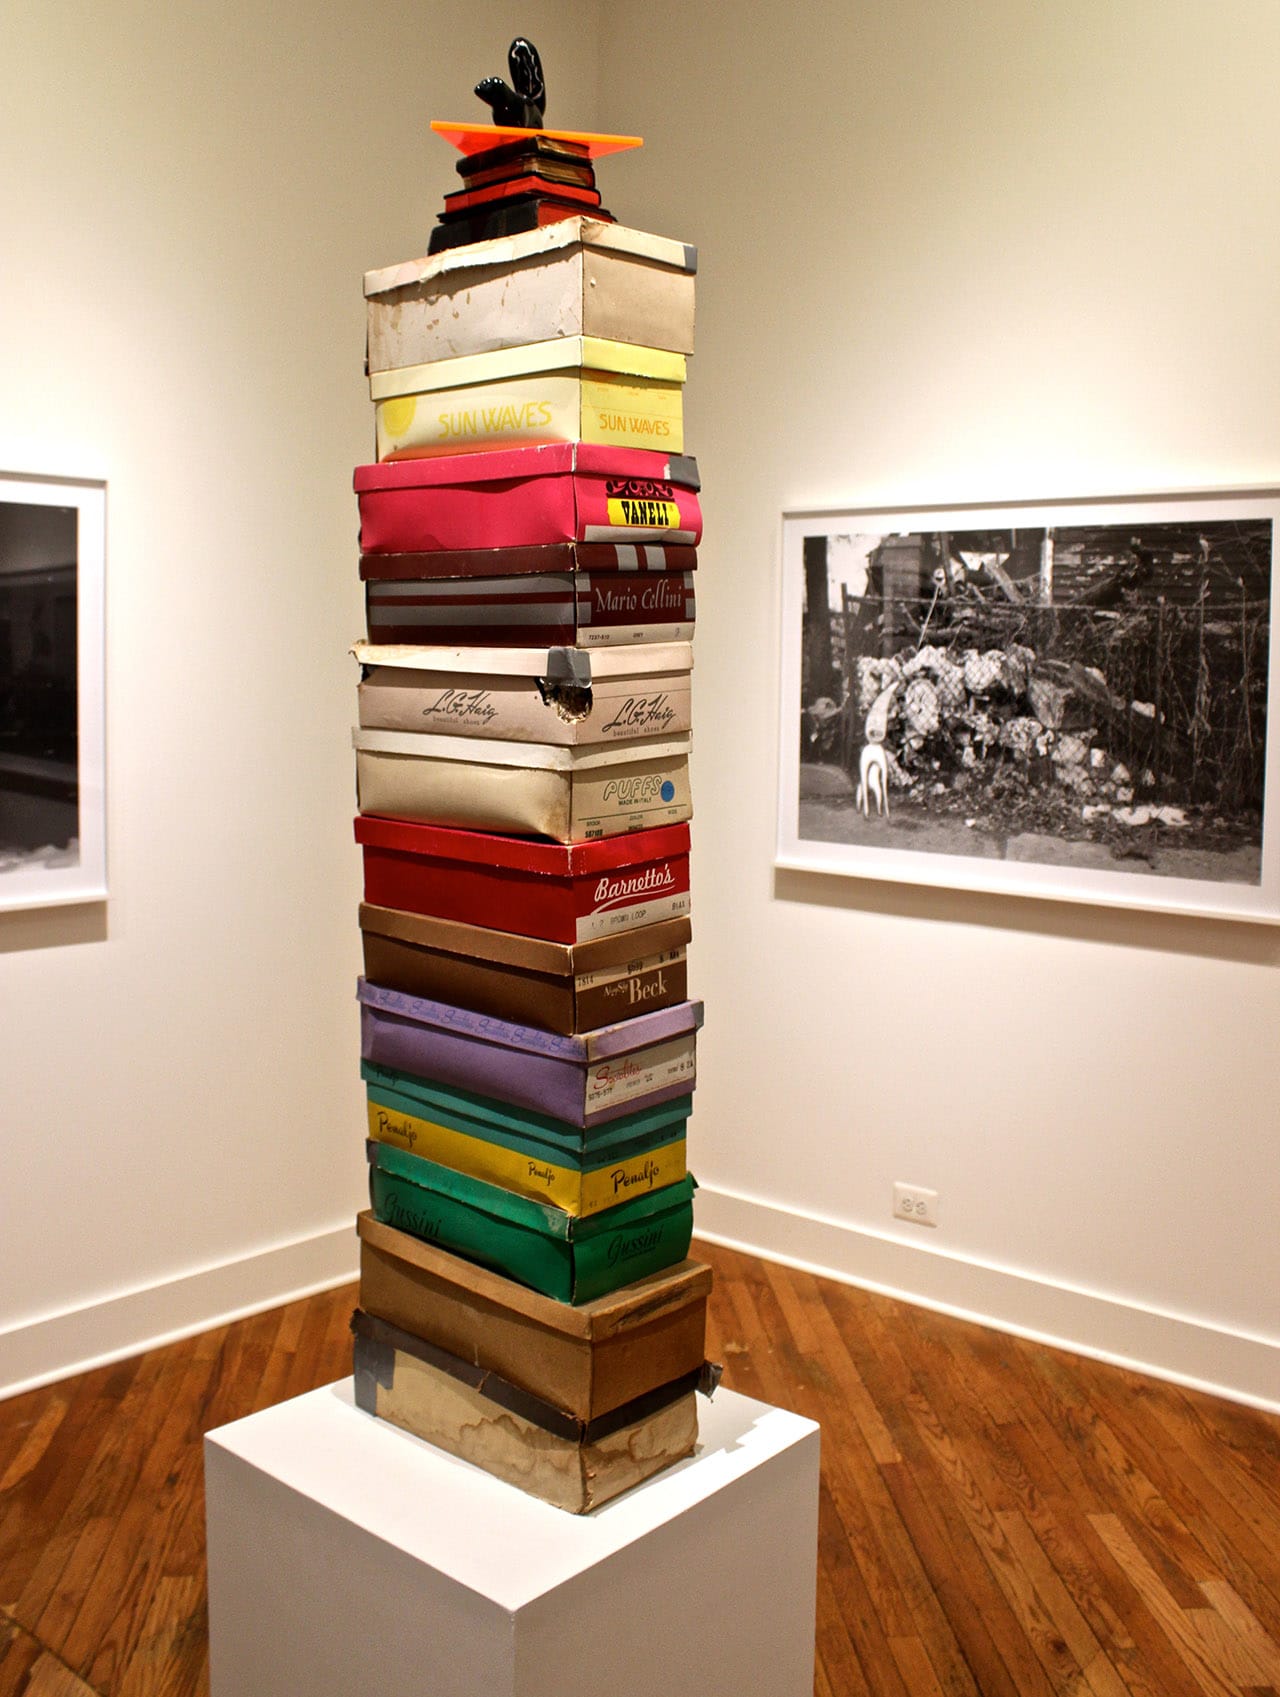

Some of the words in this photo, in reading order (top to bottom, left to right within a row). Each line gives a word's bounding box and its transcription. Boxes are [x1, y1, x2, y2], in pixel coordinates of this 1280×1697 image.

[438, 411, 478, 438] SUN
[481, 401, 552, 431] WAVES
[599, 413, 626, 432] SUN
[630, 418, 670, 436] WAVES
[621, 501, 669, 526] VANELI
[595, 586, 637, 612] Mario
[641, 579, 682, 610] Cellini
[603, 775, 662, 801] PUFFS
[594, 863, 676, 902] Barnetto's
[628, 970, 668, 1004] Beck
[377, 1111, 417, 1147] Penaljo
[528, 1162, 556, 1187] Penaljo
[610, 1160, 660, 1194] Penaljo
